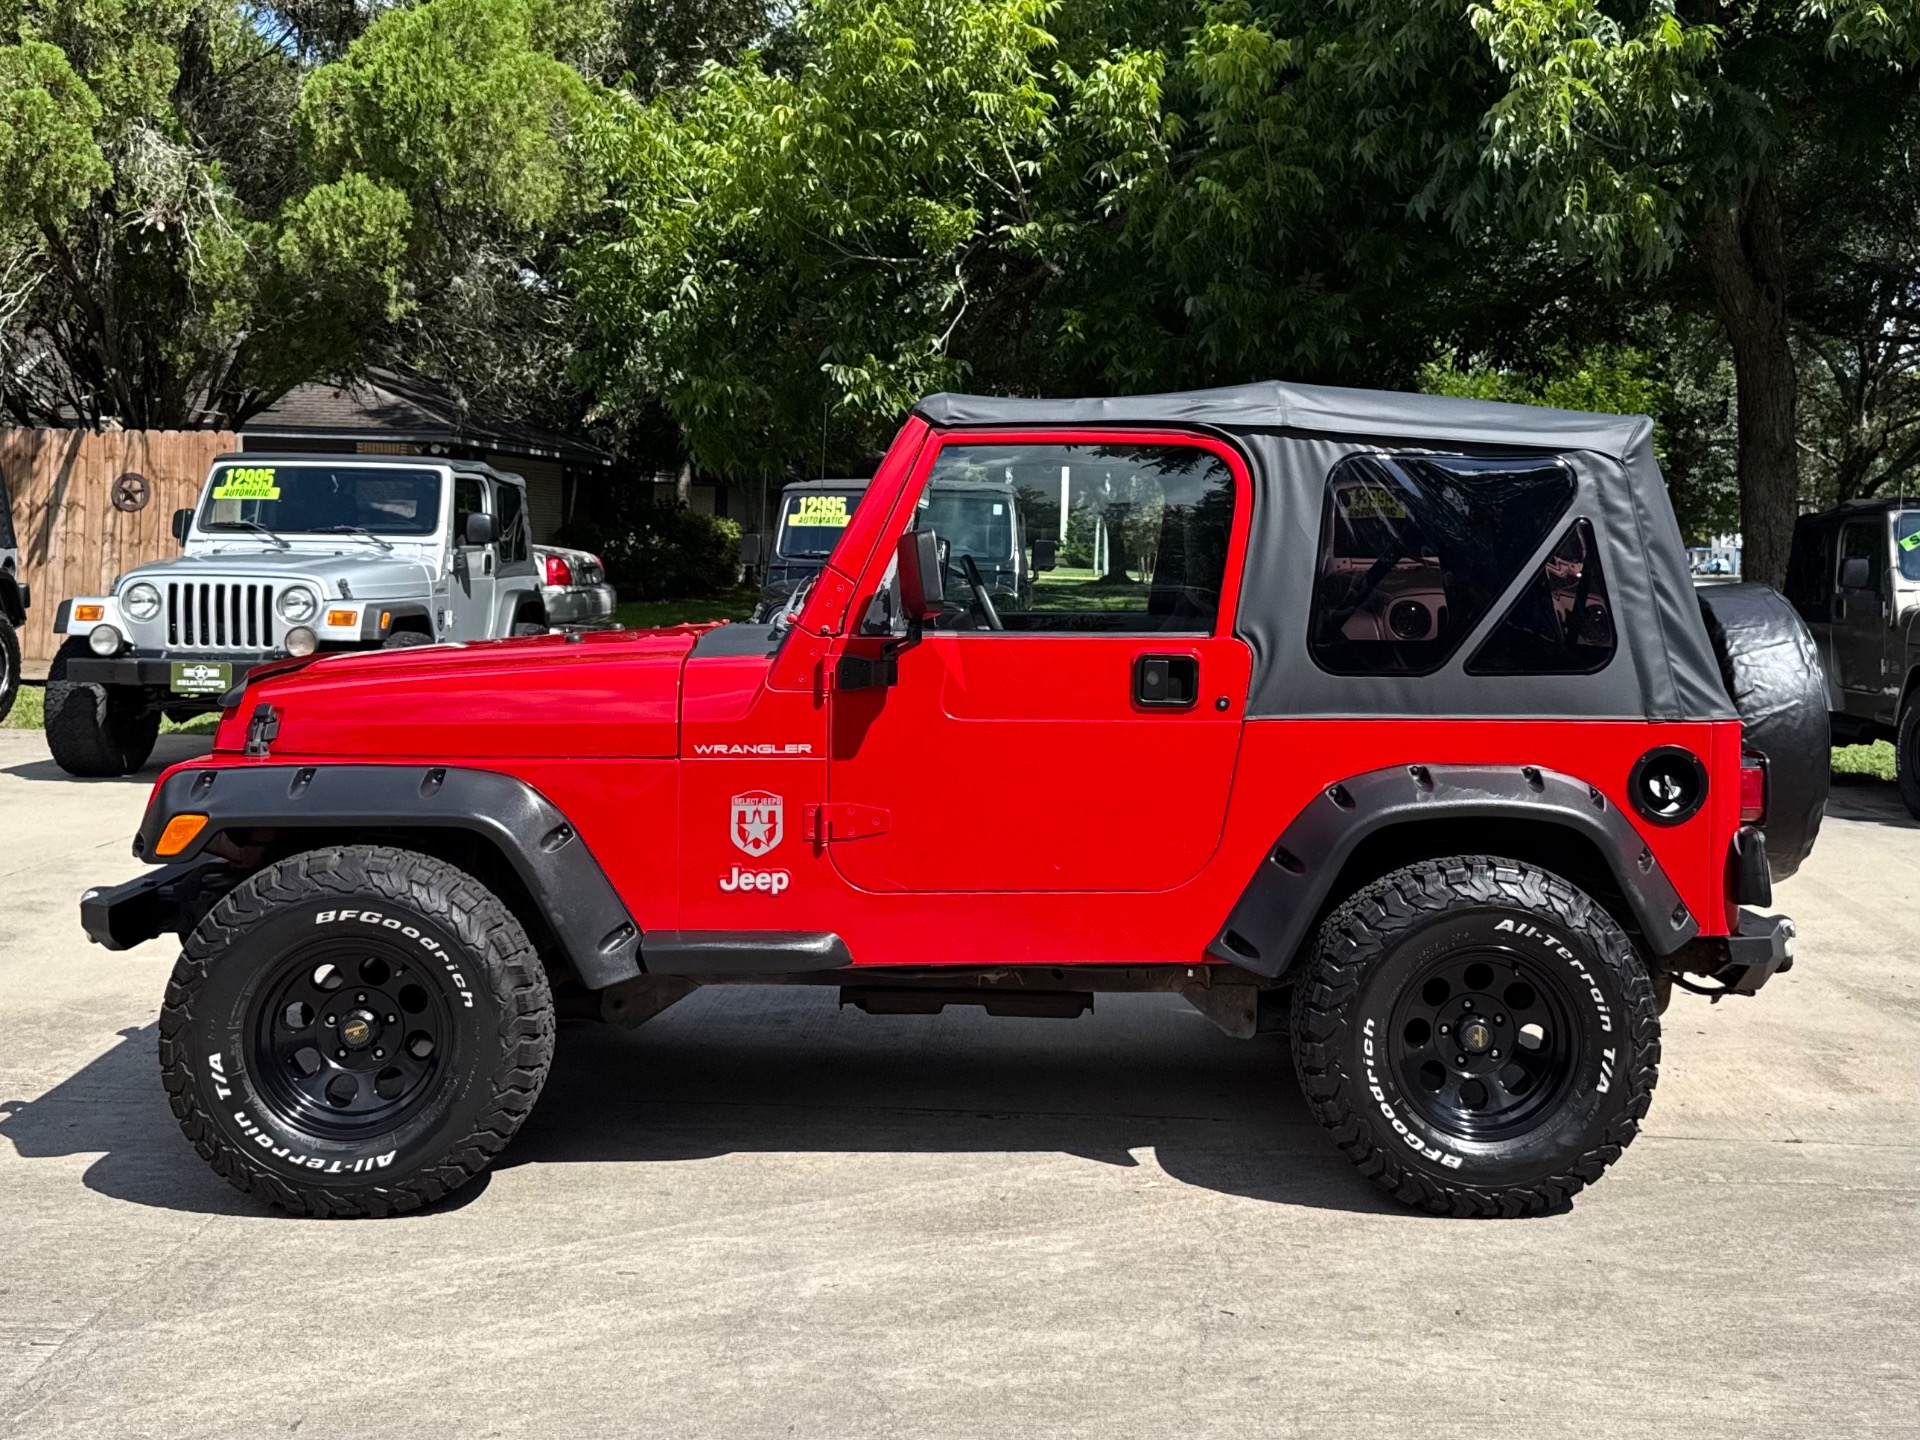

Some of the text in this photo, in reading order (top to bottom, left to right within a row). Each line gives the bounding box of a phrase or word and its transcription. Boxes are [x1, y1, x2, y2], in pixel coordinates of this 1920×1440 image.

[225, 468, 275, 488] 12995
[223, 489, 271, 497] AUTOMATIC
[799, 496, 847, 515] 12995
[798, 516, 844, 524] AUTOMATIC
[693, 743, 813, 754] WRANGLER
[719, 866, 789, 895] Jeep
[314, 909, 474, 1008] BFGoodrich
[1494, 918, 1616, 1094] All-Terrain T/A
[1362, 1018, 1463, 1170] BFGoodrich
[208, 1052, 397, 1174] All-Terrain T/A
